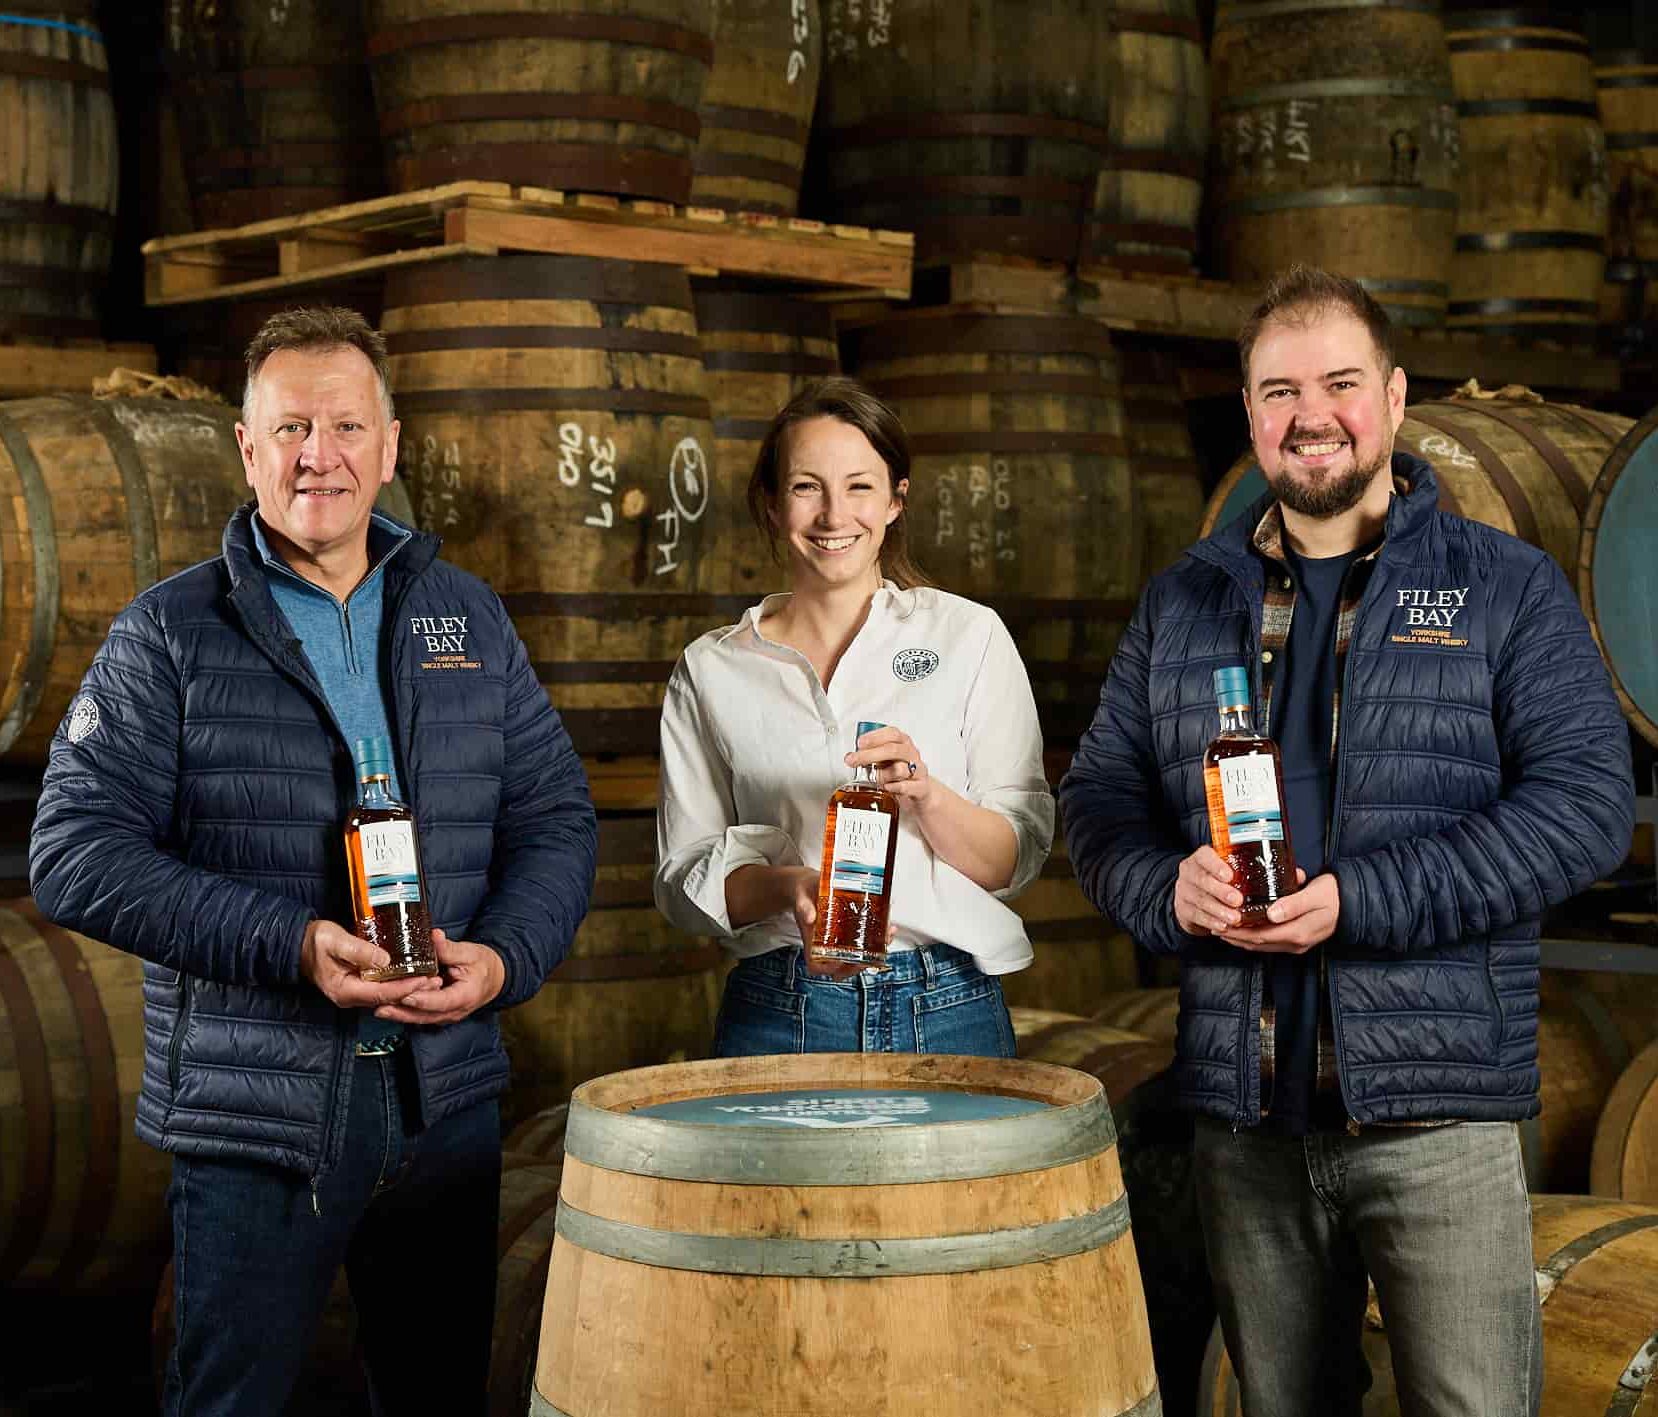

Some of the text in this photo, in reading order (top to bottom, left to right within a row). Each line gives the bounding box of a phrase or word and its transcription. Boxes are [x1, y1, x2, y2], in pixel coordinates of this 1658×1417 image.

[584, 436, 616, 529] 3517
[1396, 587, 1470, 606] FILEY
[410, 617, 468, 634] FILEY
[1406, 608, 1459, 627] BAY
[424, 635, 466, 652] BAY
[1225, 768, 1270, 785] FILY
[365, 833, 411, 849] FILY
